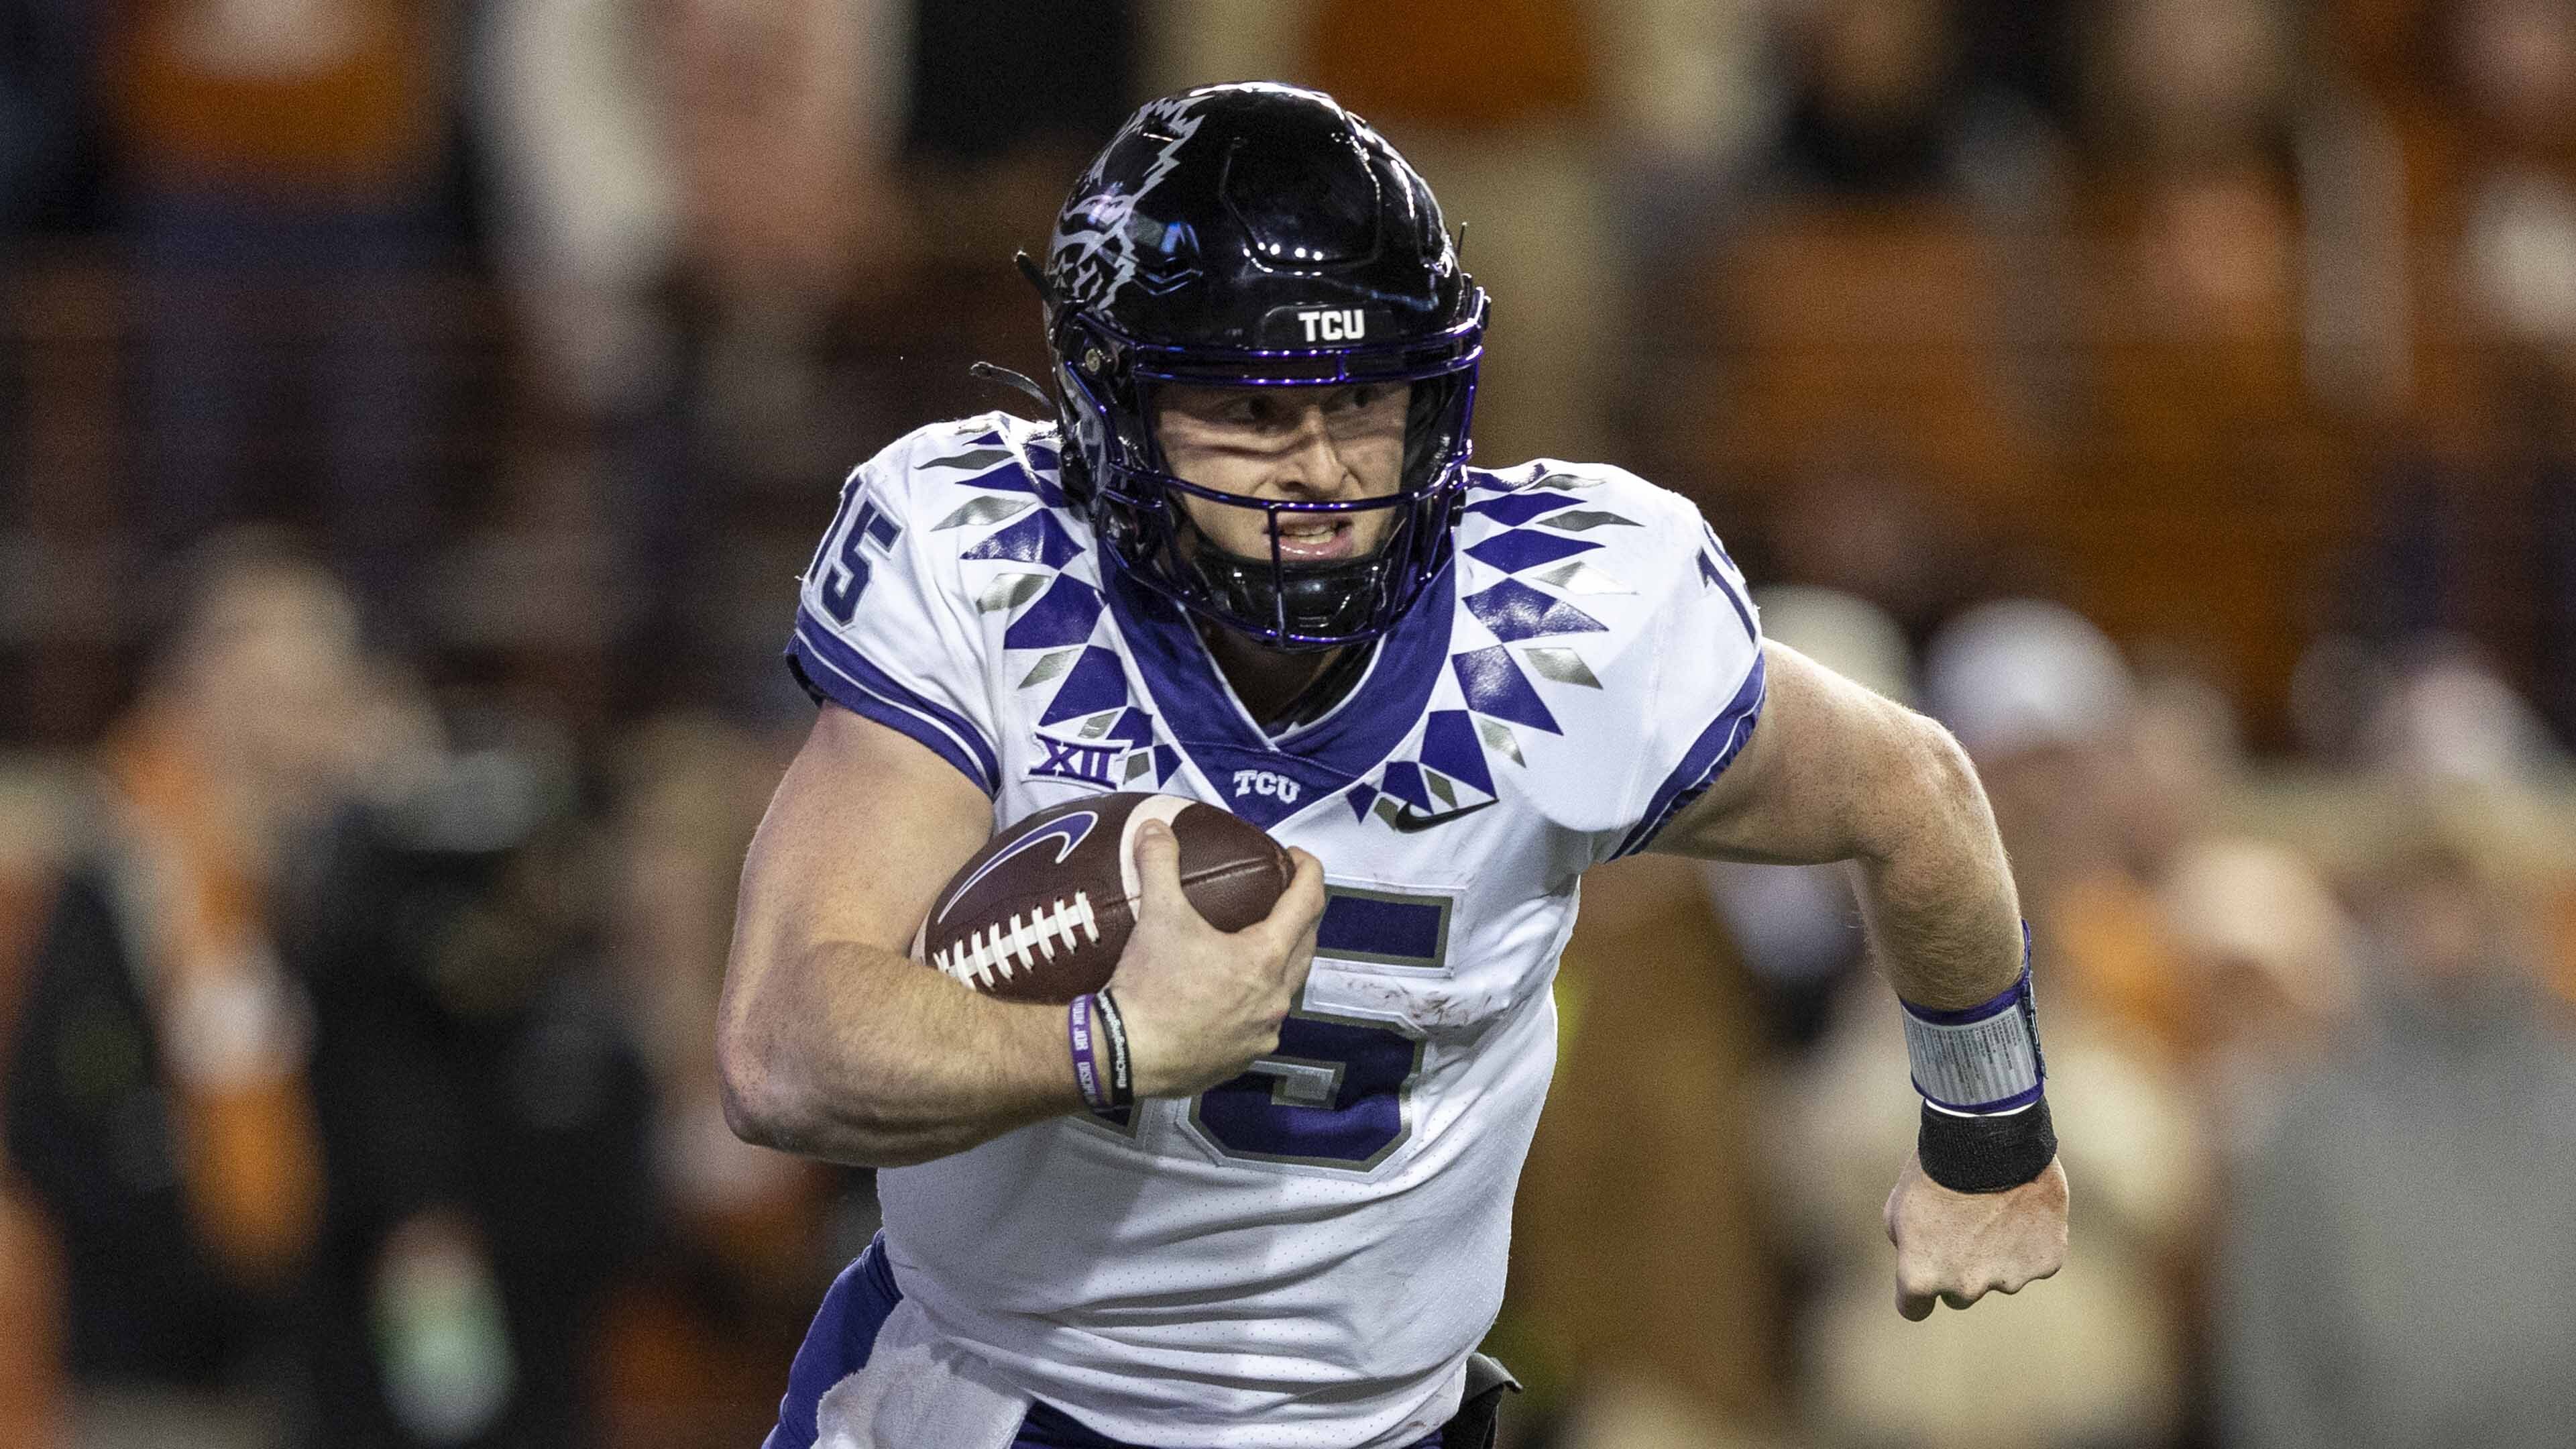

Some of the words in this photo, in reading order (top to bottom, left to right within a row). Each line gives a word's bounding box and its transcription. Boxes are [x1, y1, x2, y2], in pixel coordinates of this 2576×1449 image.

[1298, 309, 1365, 342] TCU
[808, 472, 903, 627] 15
[1695, 521, 1758, 650] 1
[1028, 732, 1126, 791] XII
[1233, 769, 1301, 804] TCU
[1081, 883, 1455, 1174] 5
